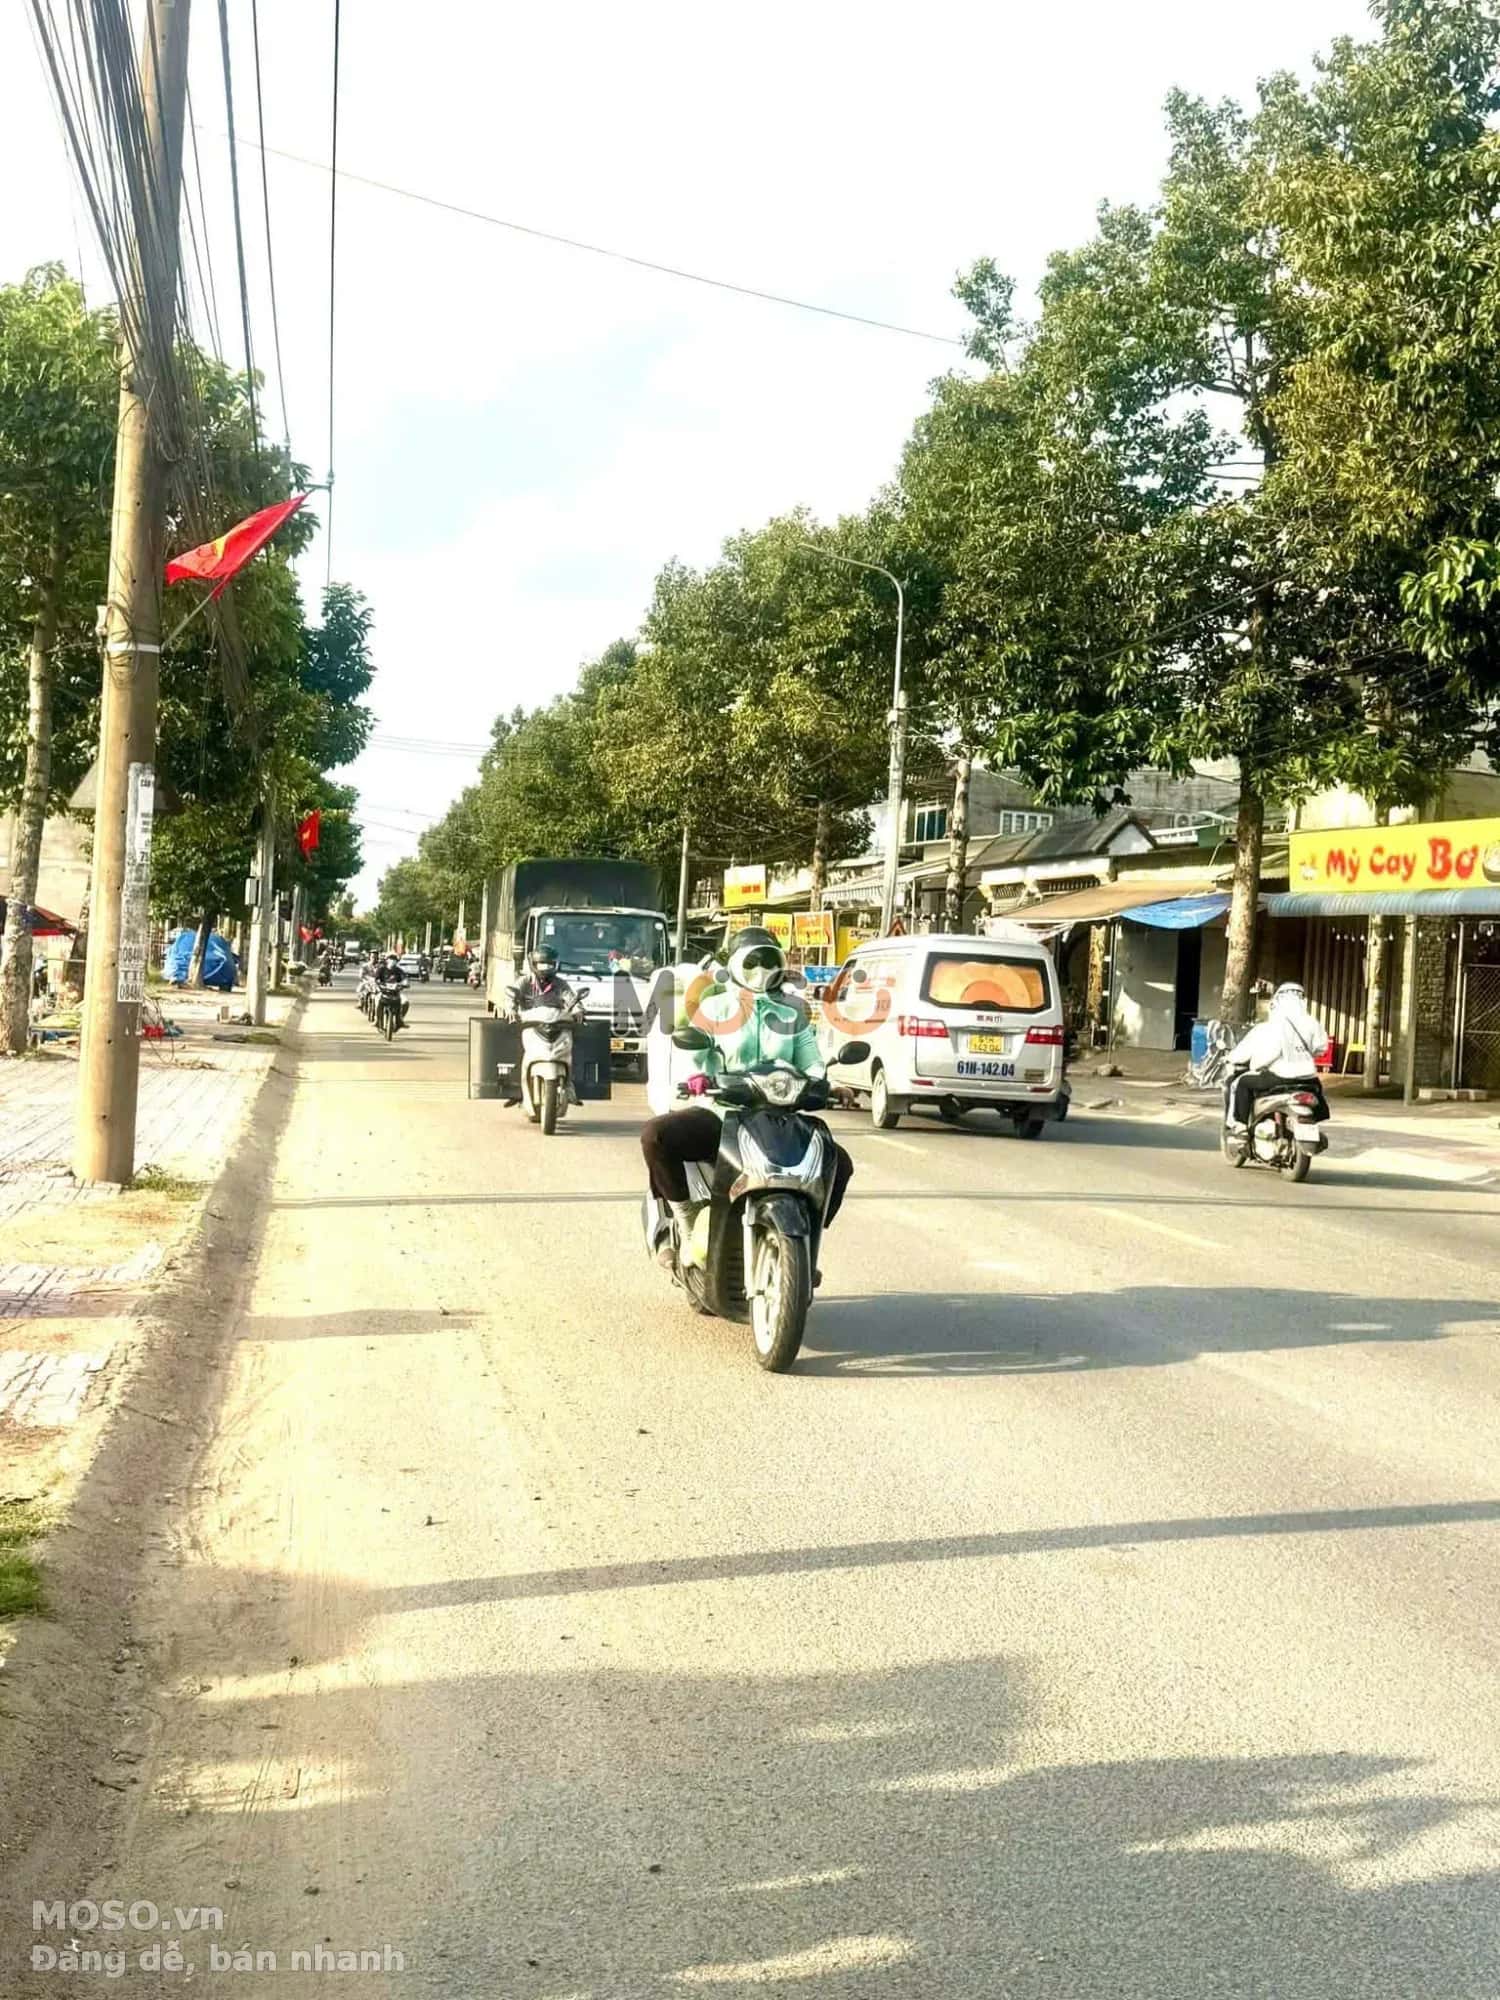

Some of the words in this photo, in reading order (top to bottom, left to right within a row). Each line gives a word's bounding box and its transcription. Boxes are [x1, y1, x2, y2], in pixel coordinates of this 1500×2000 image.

[1369, 845, 1416, 882] Cay
[1427, 836, 1479, 881] Bơ
[957, 1061, 1015, 1077] 61H-142.04
